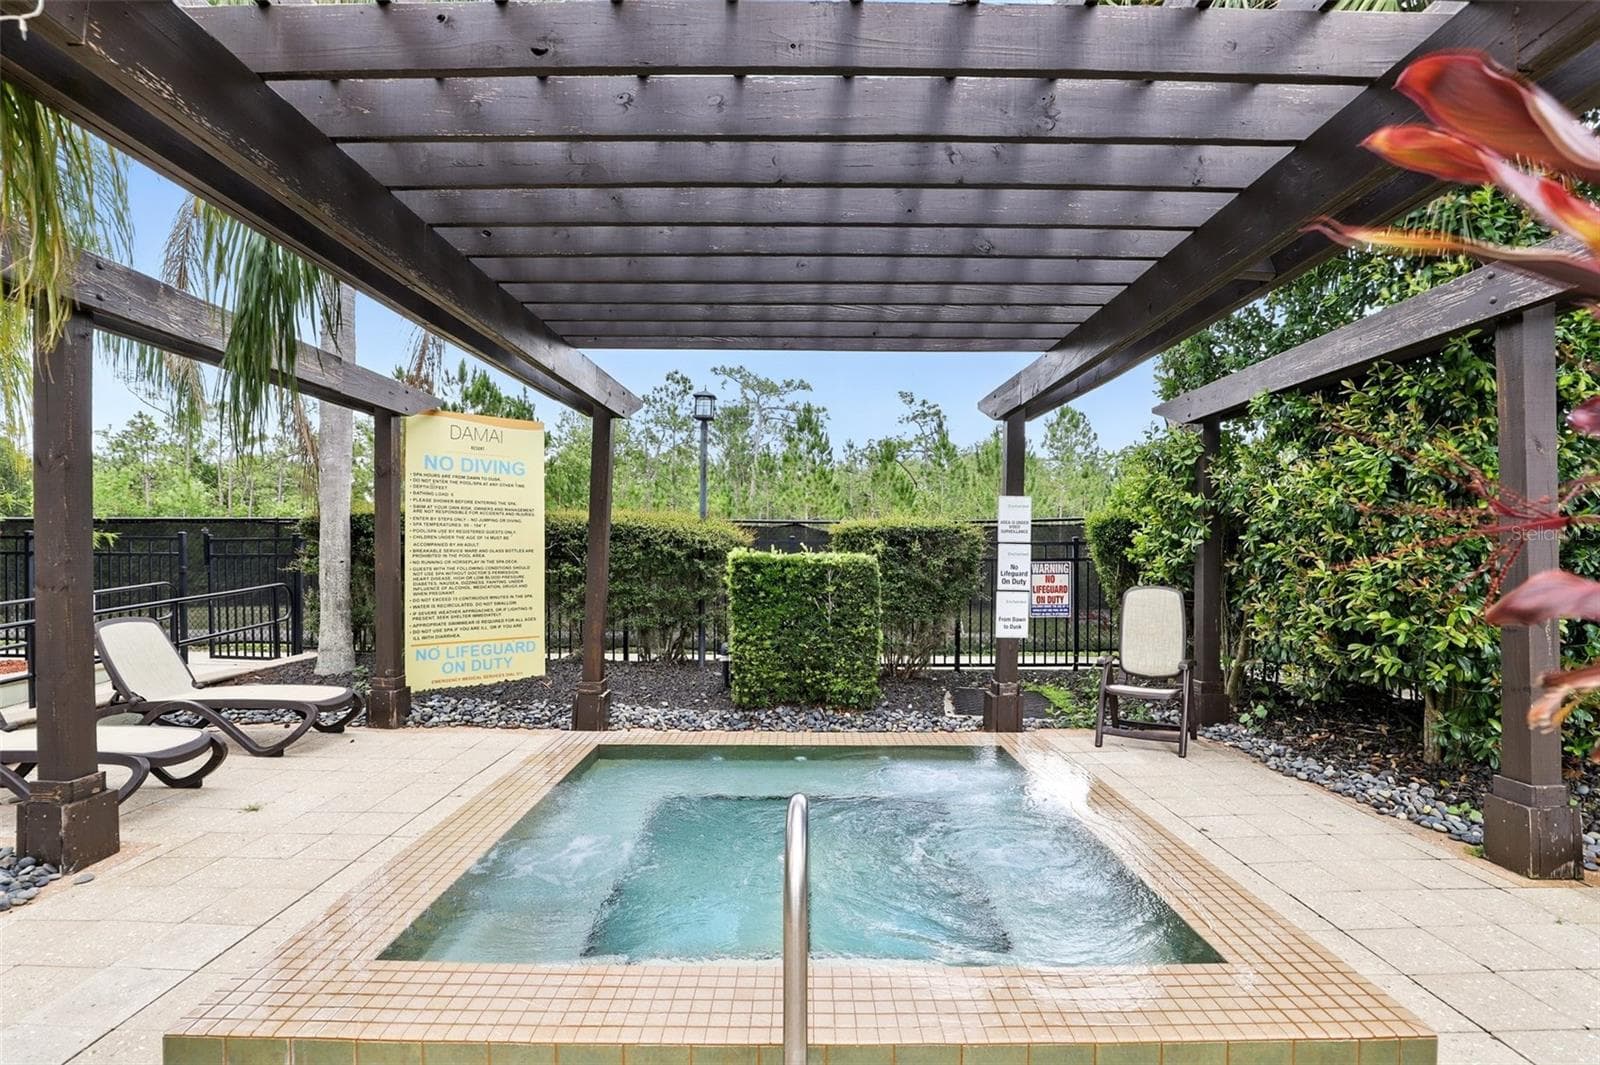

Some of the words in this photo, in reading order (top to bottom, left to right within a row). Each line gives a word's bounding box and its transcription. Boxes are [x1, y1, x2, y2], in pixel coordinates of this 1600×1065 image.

[450, 424, 503, 444] DAMAI
[424, 454, 454, 471] NO
[461, 457, 526, 477] DIVING
[1032, 563, 1069, 574] WARNING
[1000, 570, 1029, 578] Lifeguard
[1012, 578, 1026, 586] Duty
[1045, 575, 1055, 584] NO
[1033, 585, 1068, 594] LIFEGUARD
[1036, 595, 1046, 604] ON
[1047, 595, 1064, 604] DUTY
[415, 648, 440, 661] NO
[446, 641, 536, 659] LIFEGUARD
[441, 661, 465, 674] ON
[472, 656, 512, 672] DUTY
